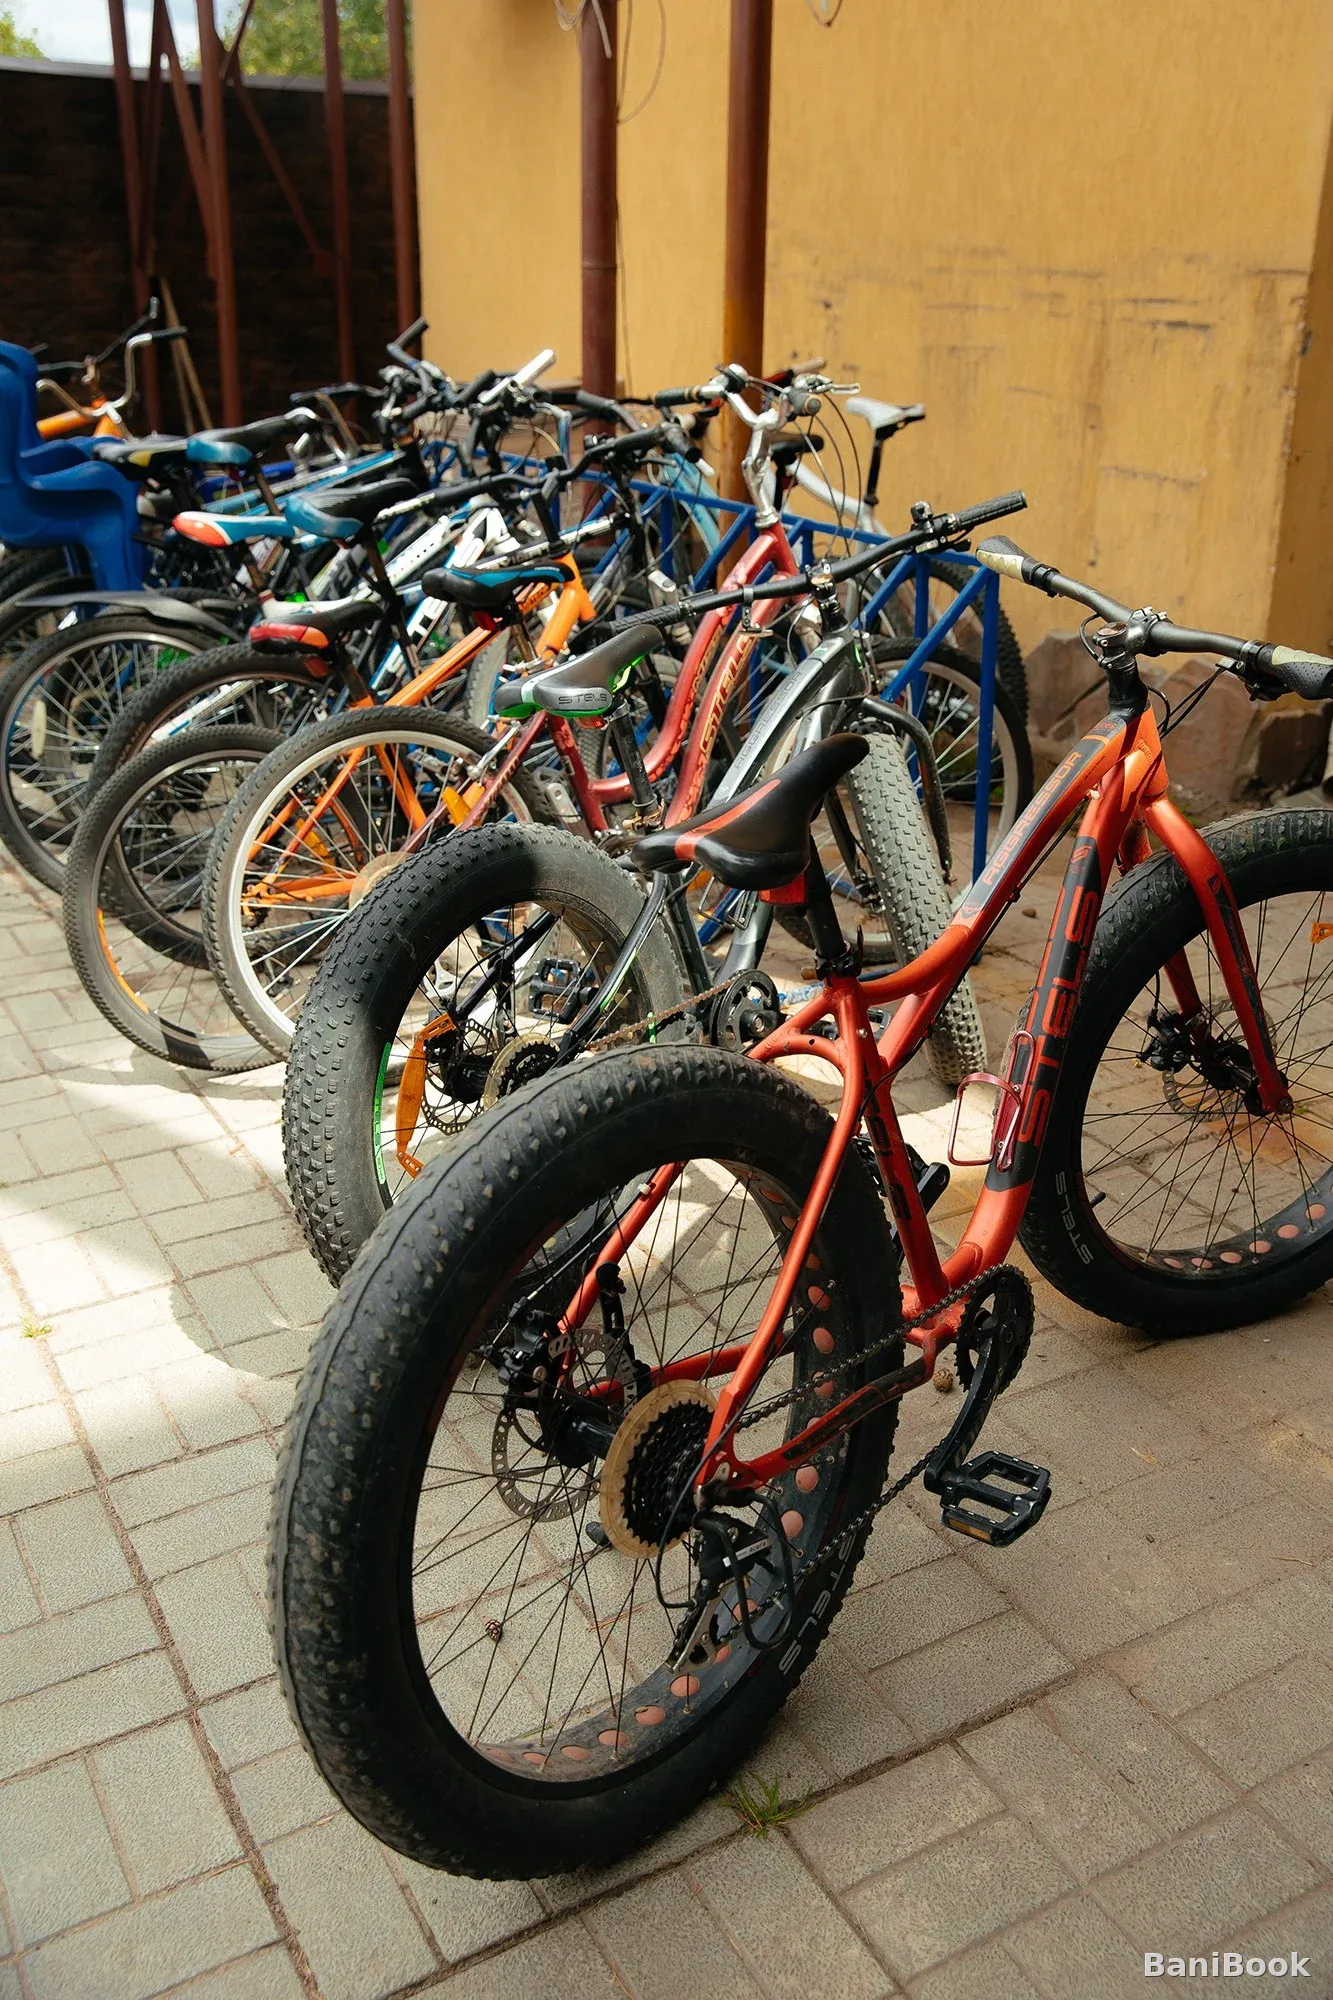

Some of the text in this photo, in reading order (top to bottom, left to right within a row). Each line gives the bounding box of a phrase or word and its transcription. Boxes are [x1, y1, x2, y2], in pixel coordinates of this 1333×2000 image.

[558, 693, 608, 704] STELS
[734, 672, 802, 770] AGGRESSOR
[983, 751, 1082, 885] AGGRESSOR
[1017, 885, 1098, 1147] STELS
[1055, 1171, 1094, 1265] STELS
